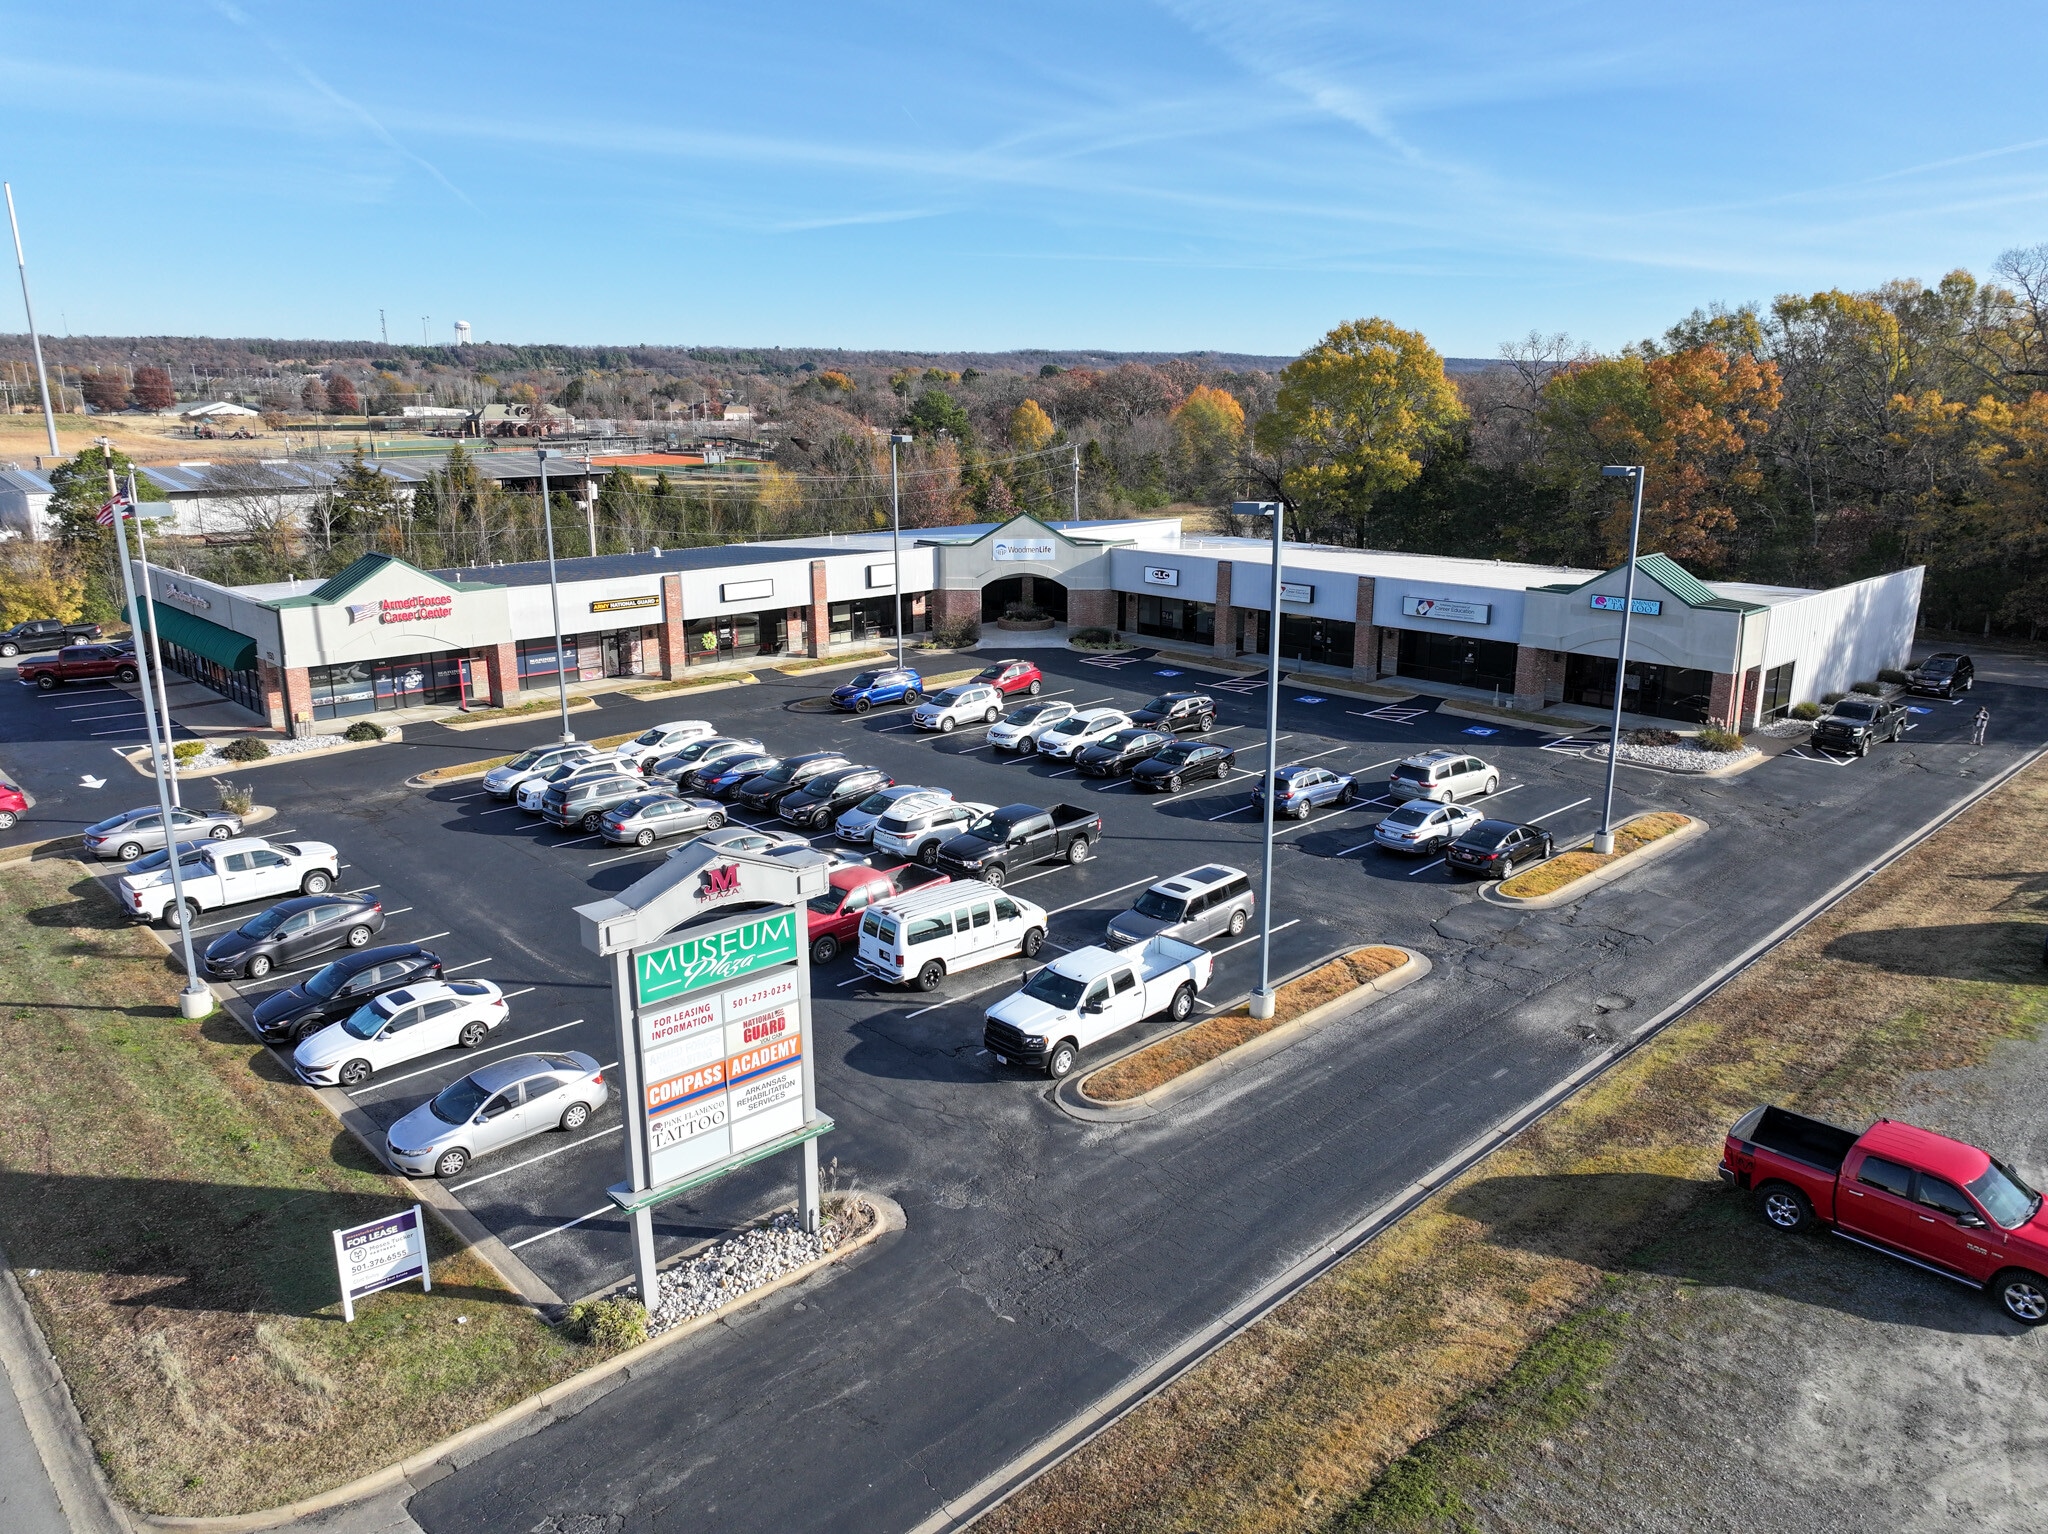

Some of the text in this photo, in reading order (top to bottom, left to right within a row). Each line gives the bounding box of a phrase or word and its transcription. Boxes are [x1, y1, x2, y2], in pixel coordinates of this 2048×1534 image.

[382, 596, 452, 610] Armed Forces
[383, 607, 452, 623] Career Center
[704, 863, 741, 894] M
[700, 888, 740, 903] PLAZA
[646, 916, 790, 980] MUSEUM
[684, 952, 756, 988] Plaza
[732, 982, 792, 1008] 501-273-0234
[652, 1013, 714, 1040] INFORMATION
[654, 1003, 711, 1028] FOR LEASING
[743, 1011, 775, 1028] NATIONAL
[744, 1016, 786, 1043] GUARD
[771, 1032, 783, 1041] CAN
[732, 1038, 798, 1076] ACADEMY
[649, 1065, 722, 1105] COMPASS
[736, 1080, 795, 1108] REHABILITATION
[745, 1075, 786, 1096] ARKANSAS
[748, 1092, 786, 1111] SERVICES
[652, 1110, 725, 1147] TATTOO
[346, 1225, 398, 1248] FOR LEASE
[369, 1233, 413, 1251] Moses Tucker
[352, 1250, 407, 1273] 501.376.6555
